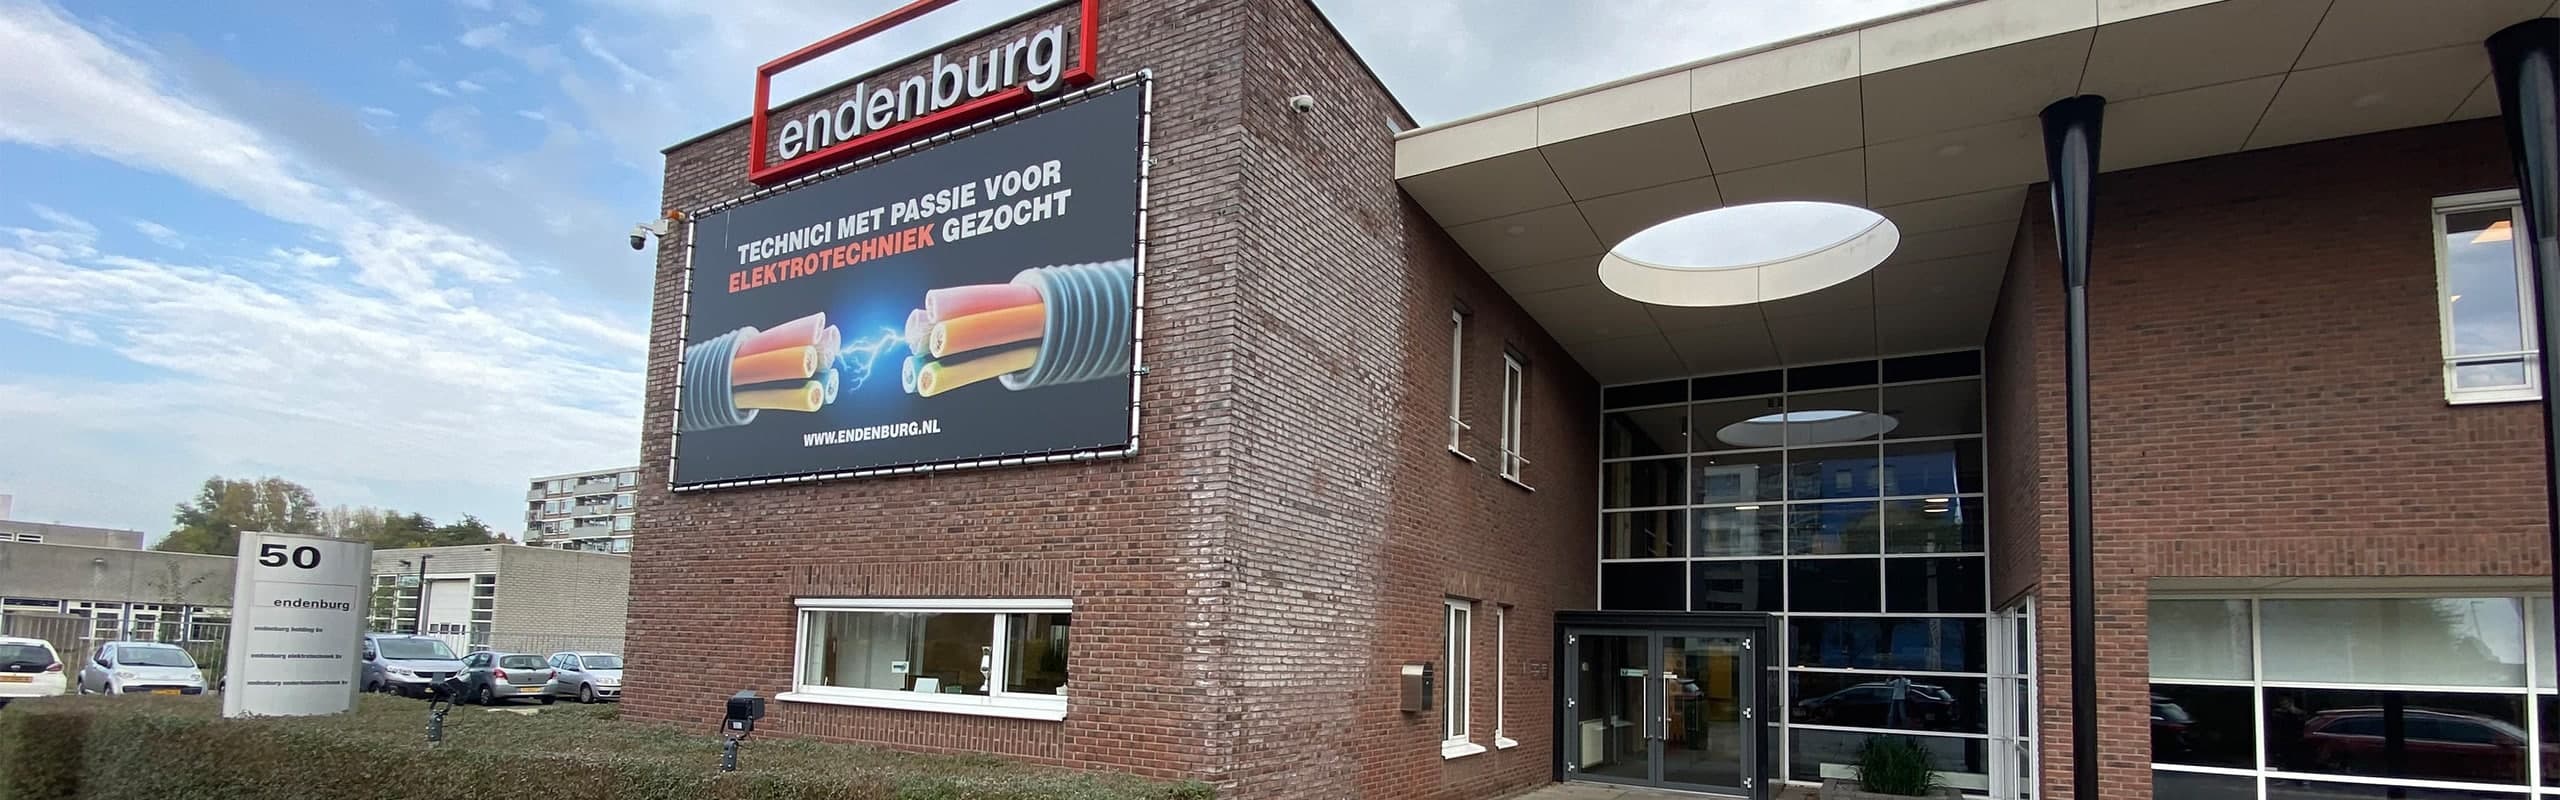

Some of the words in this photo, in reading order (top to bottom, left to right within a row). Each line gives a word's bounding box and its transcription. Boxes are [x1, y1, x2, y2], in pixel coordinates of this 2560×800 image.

[778, 24, 1063, 161] endenburg
[728, 223, 935, 293] ELEKTROTECHNIEK
[942, 189, 1072, 243] GEZOCHT
[737, 221, 831, 265] TECHNICI
[837, 207, 885, 240] MET
[890, 182, 977, 227] PASSIE
[984, 159, 1062, 201] VOOR
[803, 419, 941, 447] WWW.ENDENBURG.NL
[258, 543, 321, 569] 50
[273, 598, 350, 612] endenburg
